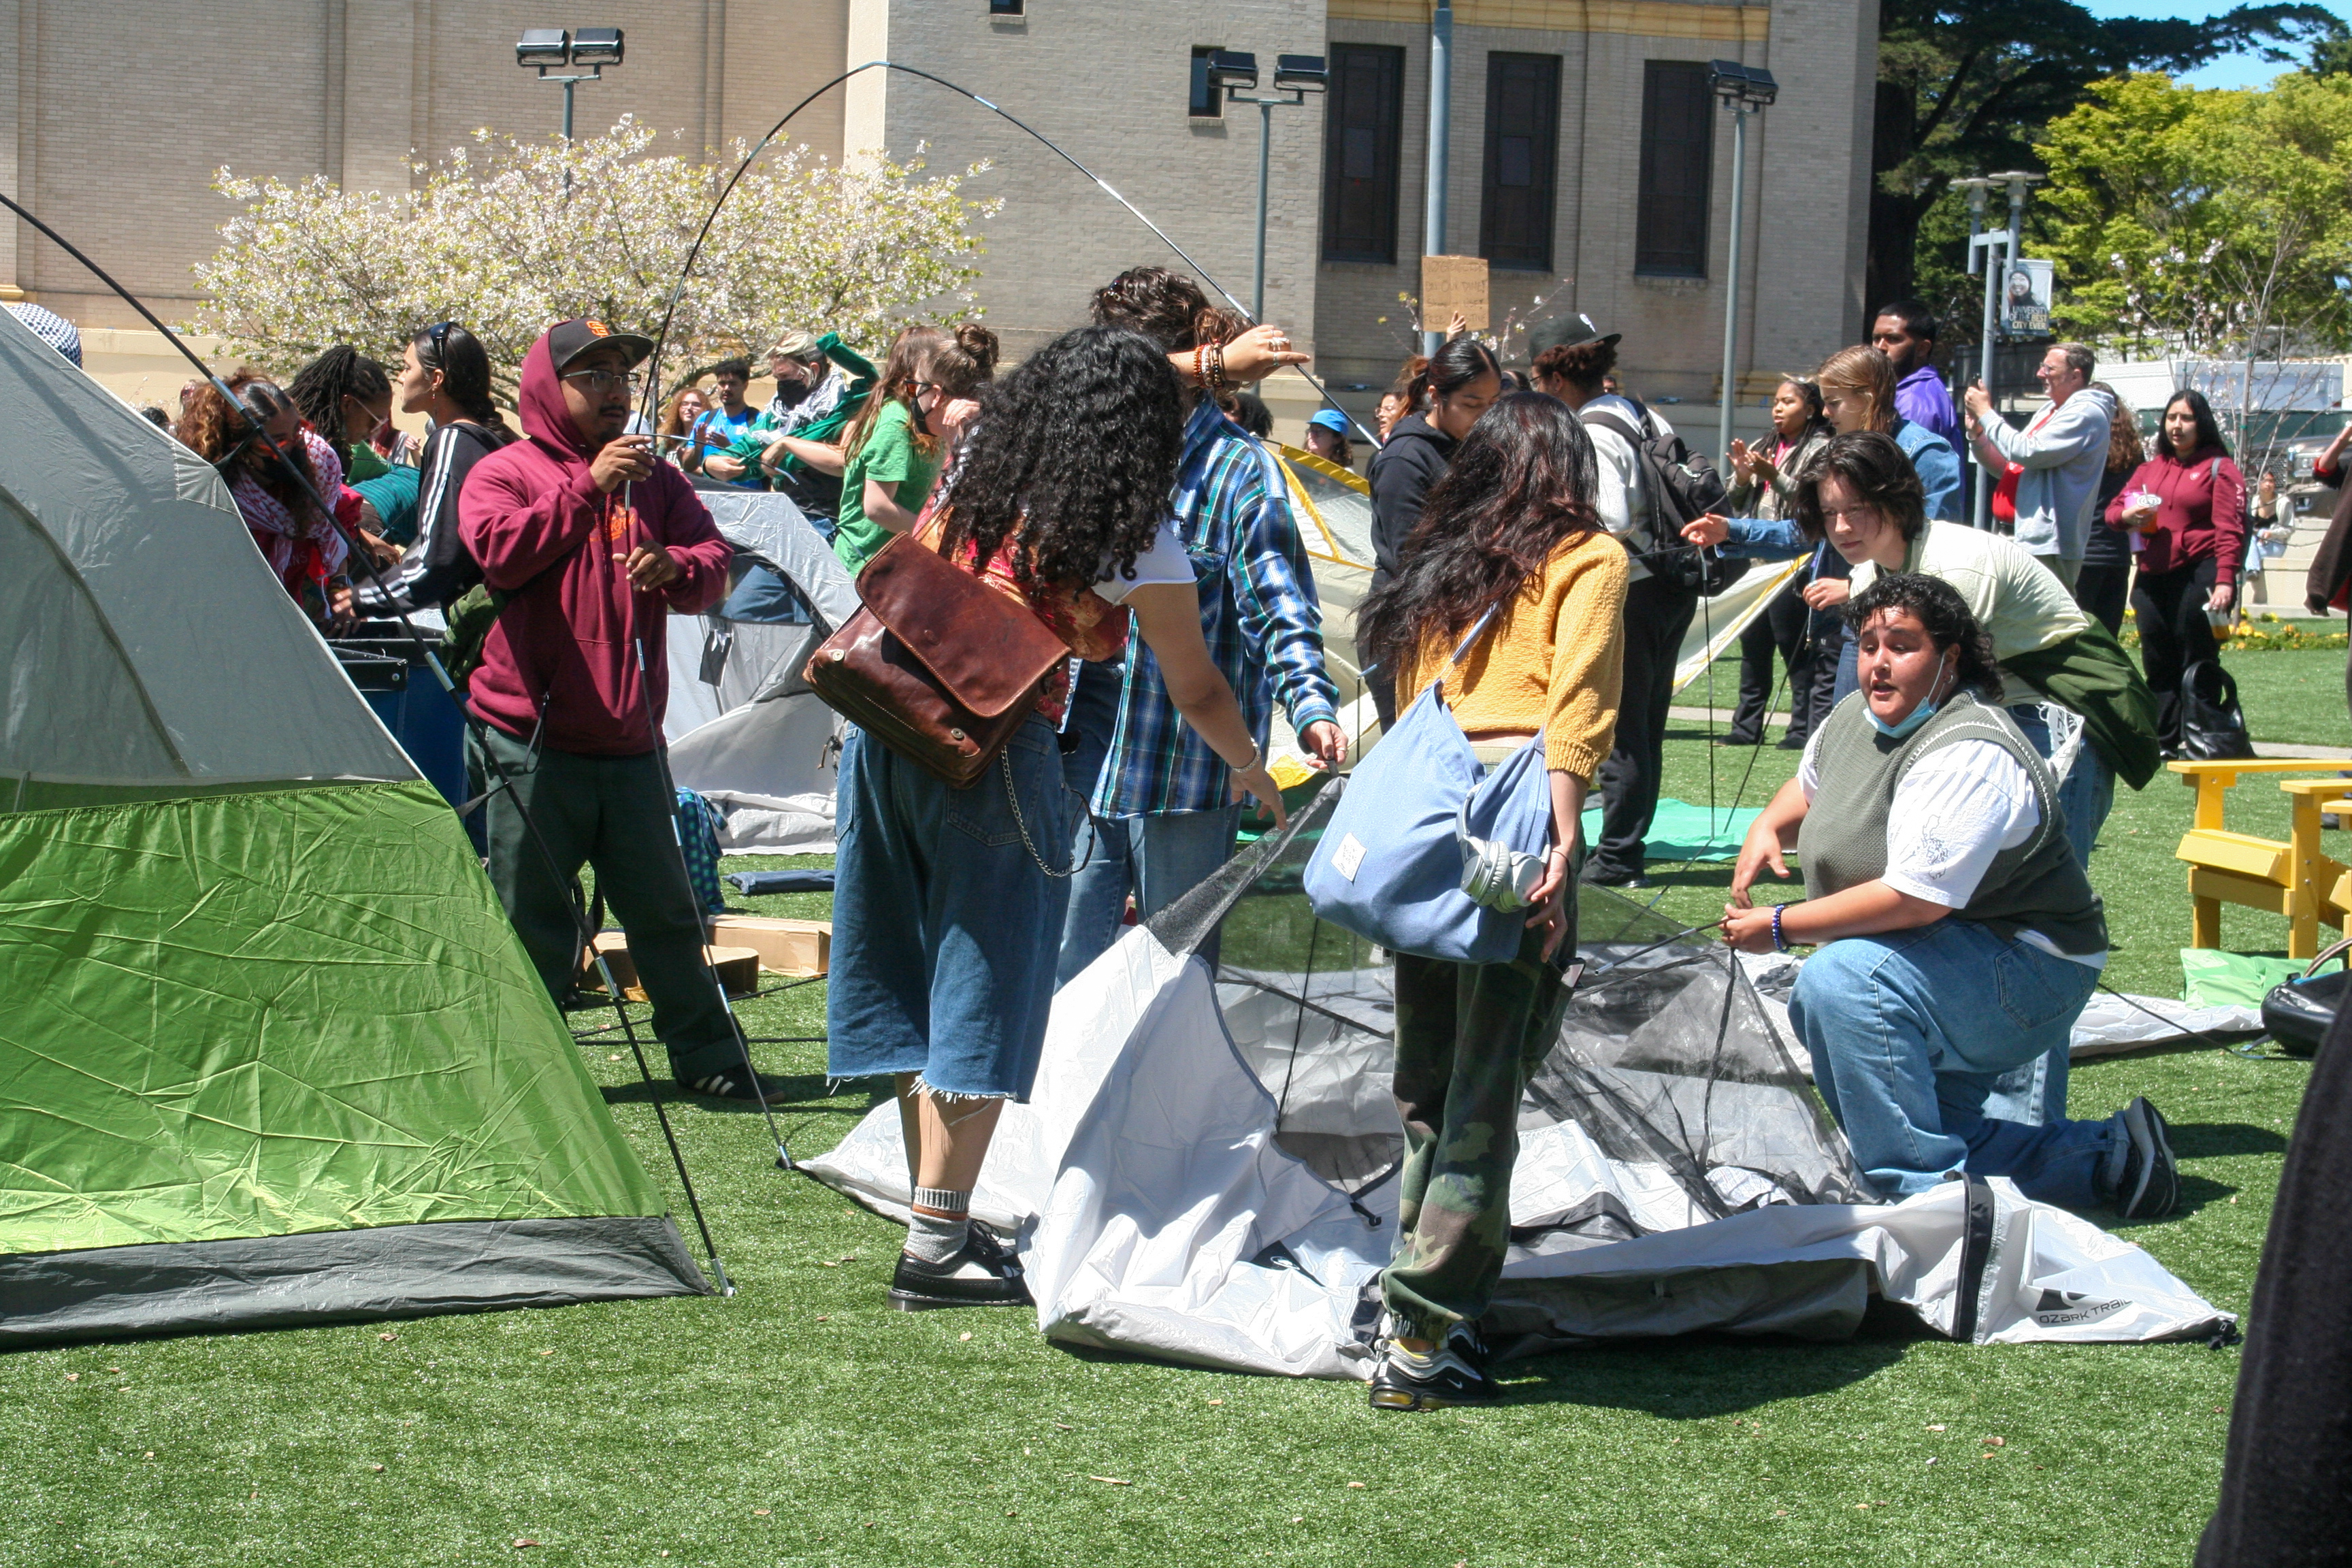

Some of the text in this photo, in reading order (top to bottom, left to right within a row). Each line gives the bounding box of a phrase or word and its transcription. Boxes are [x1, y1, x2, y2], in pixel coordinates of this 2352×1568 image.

[2012, 306, 2046, 314] UNIVERSITY
[2009, 313, 2016, 321] OF
[2031, 314, 2047, 323] BEST
[2012, 321, 2046, 330] CITY EVER
